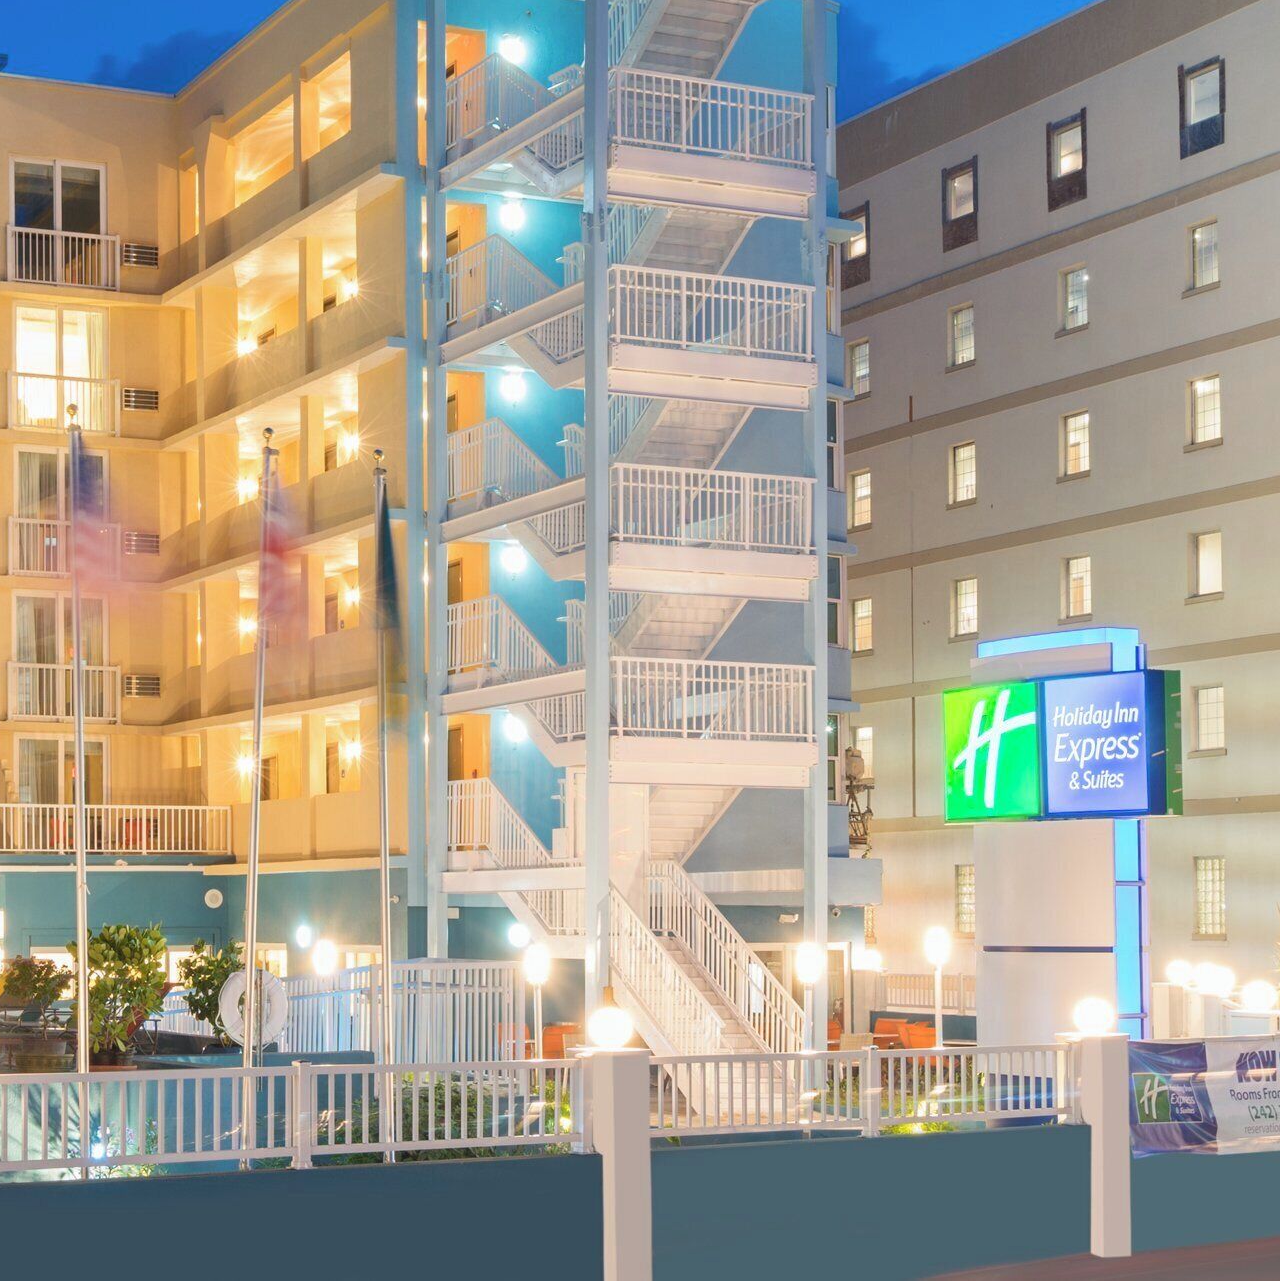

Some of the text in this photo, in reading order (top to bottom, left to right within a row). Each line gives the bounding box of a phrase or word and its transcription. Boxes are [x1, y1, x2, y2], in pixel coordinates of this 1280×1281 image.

[1052, 701, 1139, 730] Holiday Inn
[1053, 731, 1141, 769] Express
[1069, 769, 1124, 790] & Suites
[1235, 1049, 1277, 1084] NOW
[1229, 1088, 1262, 1101] Rooms
[1248, 1103, 1278, 1122] (242)
